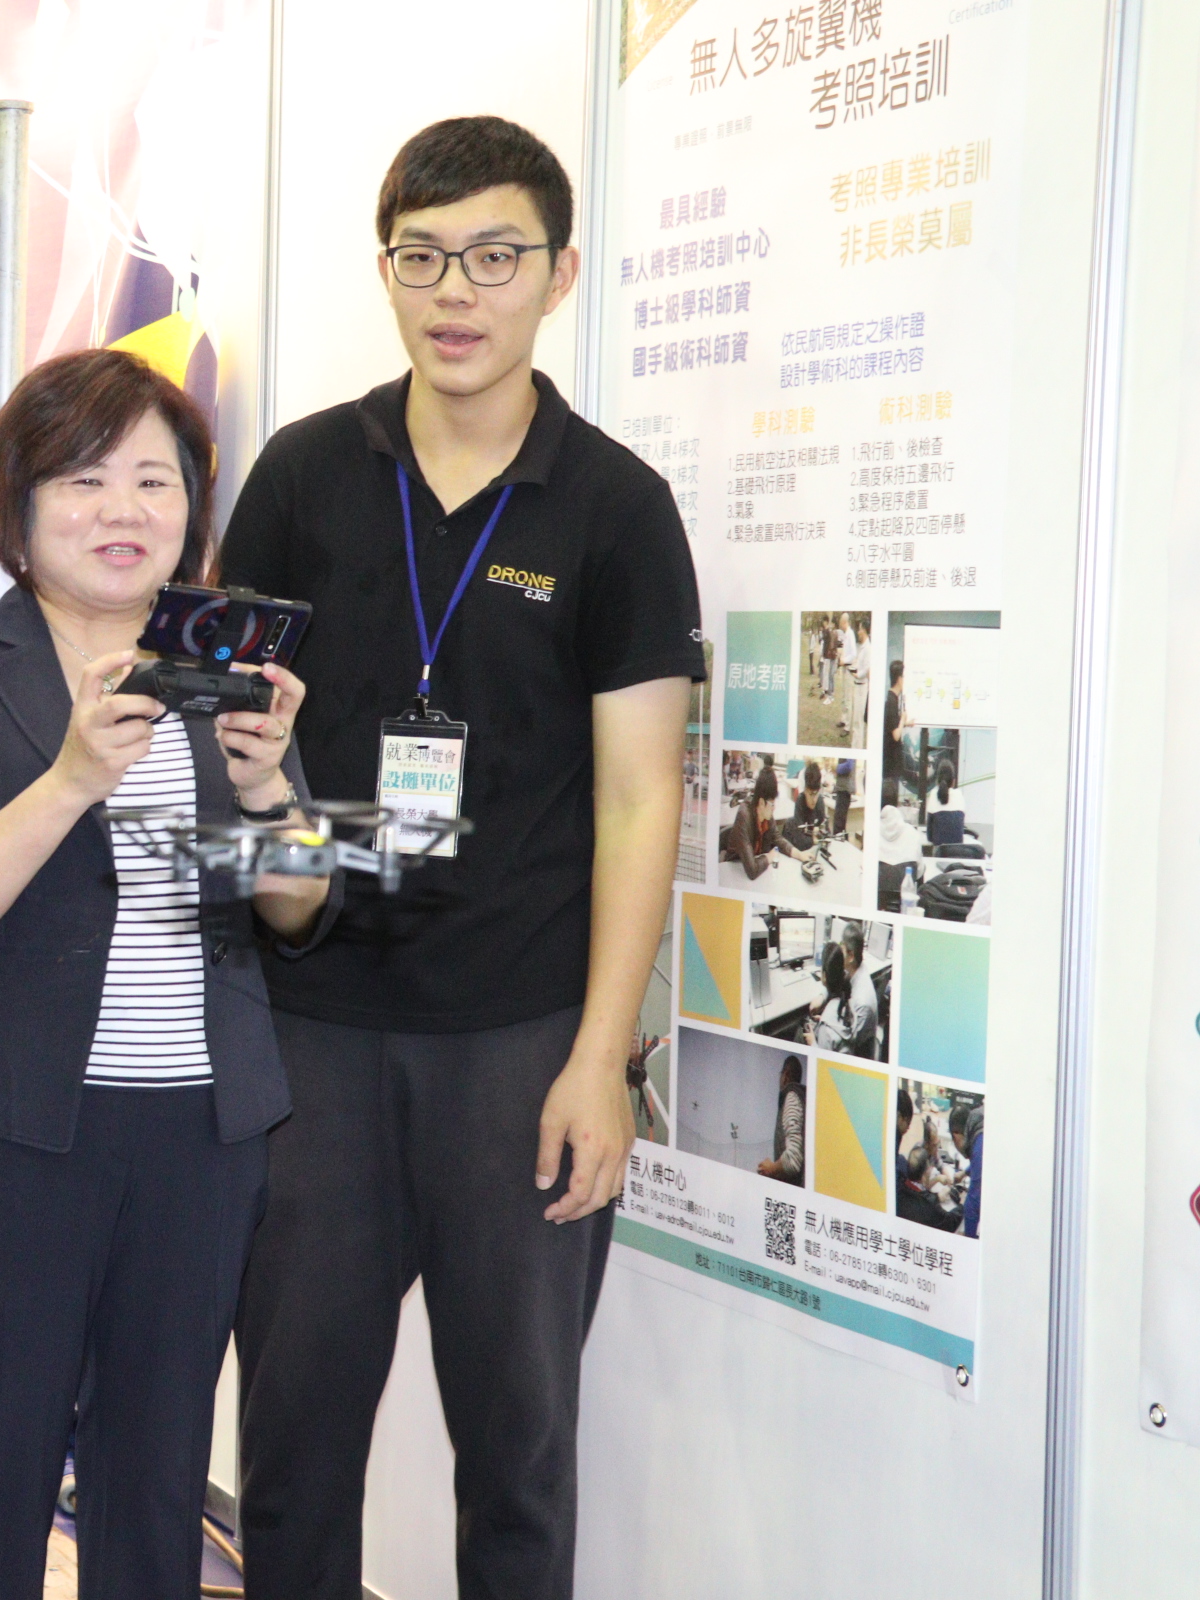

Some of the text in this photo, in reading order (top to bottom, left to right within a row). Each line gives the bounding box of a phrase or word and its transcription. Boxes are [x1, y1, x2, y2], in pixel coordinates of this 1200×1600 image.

[689, 0, 883, 96] 無人多旋翼機
[808, 34, 950, 130] 考照培訓
[830, 138, 991, 213] 考照專業培訓
[659, 186, 727, 229] 最具經驗
[840, 201, 973, 268] 非長榮莫屬
[620, 227, 770, 287] 無人機考照培訓中心
[634, 281, 751, 330] 博士級學科師資
[632, 331, 749, 377] 國手級術科師資
[781, 312, 926, 357] 依民航局規定之操作證
[780, 346, 925, 389] 設計學術科的課程內容
[751, 406, 815, 438] 學科測驗
[879, 390, 953, 426] 術科測驗
[850, 462, 955, 487] 2.高度保持五邊飛行
[849, 489, 929, 513] 3.緊急程序處置
[487, 564, 557, 591] DRONE
[524, 590, 551, 602] CJCU
[727, 663, 787, 691] 原地考照
[385, 742, 456, 764] 就業博覽會
[382, 770, 456, 792] 設攤單位
[630, 1155, 687, 1191] 無人機中心
[804, 1209, 954, 1277] 無人機應用學士學位學程
